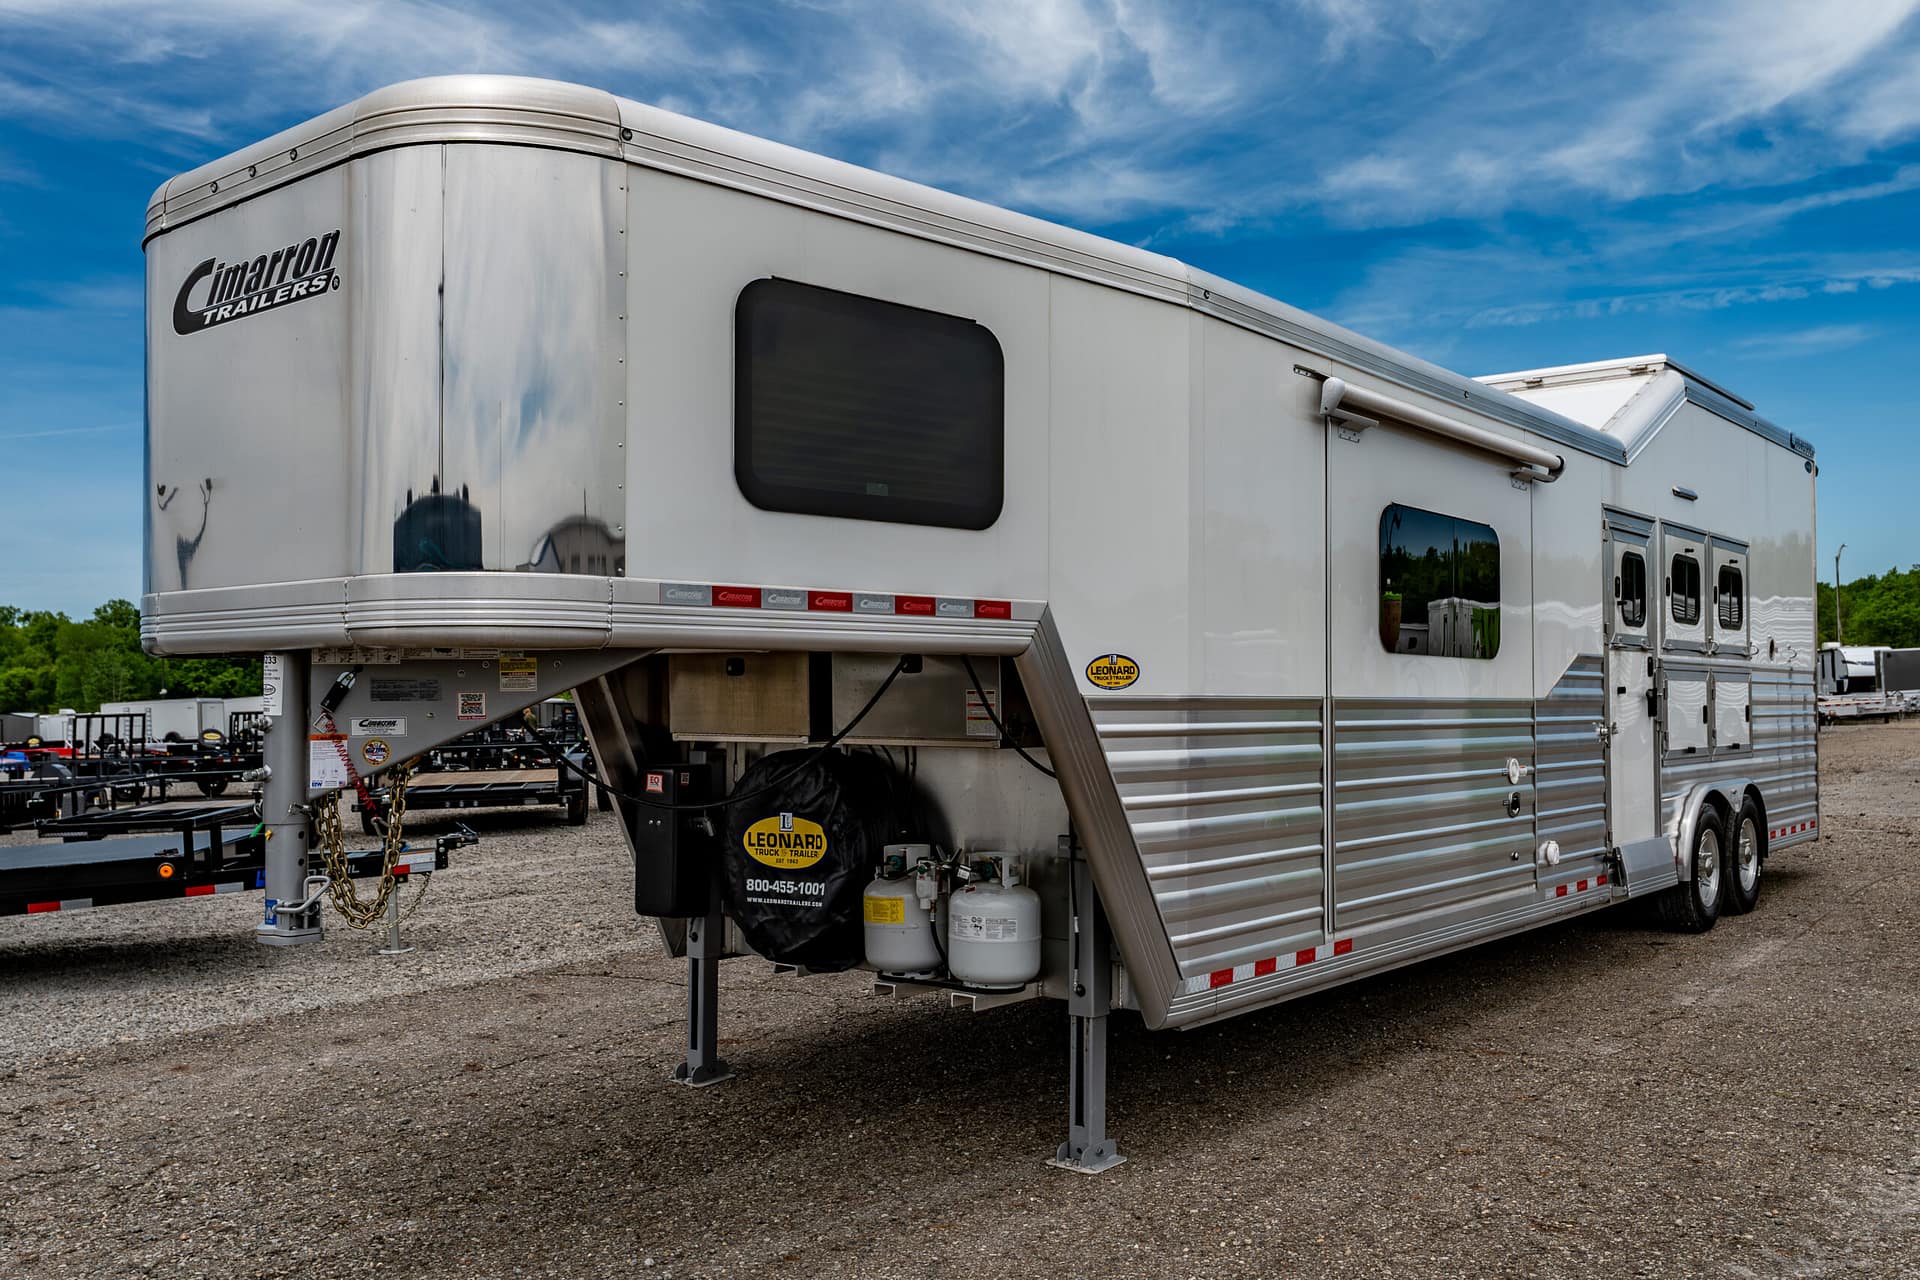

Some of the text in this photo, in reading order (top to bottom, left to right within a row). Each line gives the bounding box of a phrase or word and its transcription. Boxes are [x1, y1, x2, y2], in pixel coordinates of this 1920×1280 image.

[173, 229, 341, 336] Cimarron
[203, 274, 327, 326] TRAILERS
[1090, 665, 1135, 675] LEONARD
[650, 775, 660, 786] EQ
[747, 831, 823, 850] LEONARD
[754, 848, 780, 857] TRUCK
[789, 849, 819, 858] TRAILER
[746, 879, 825, 896] 800-455-1001
